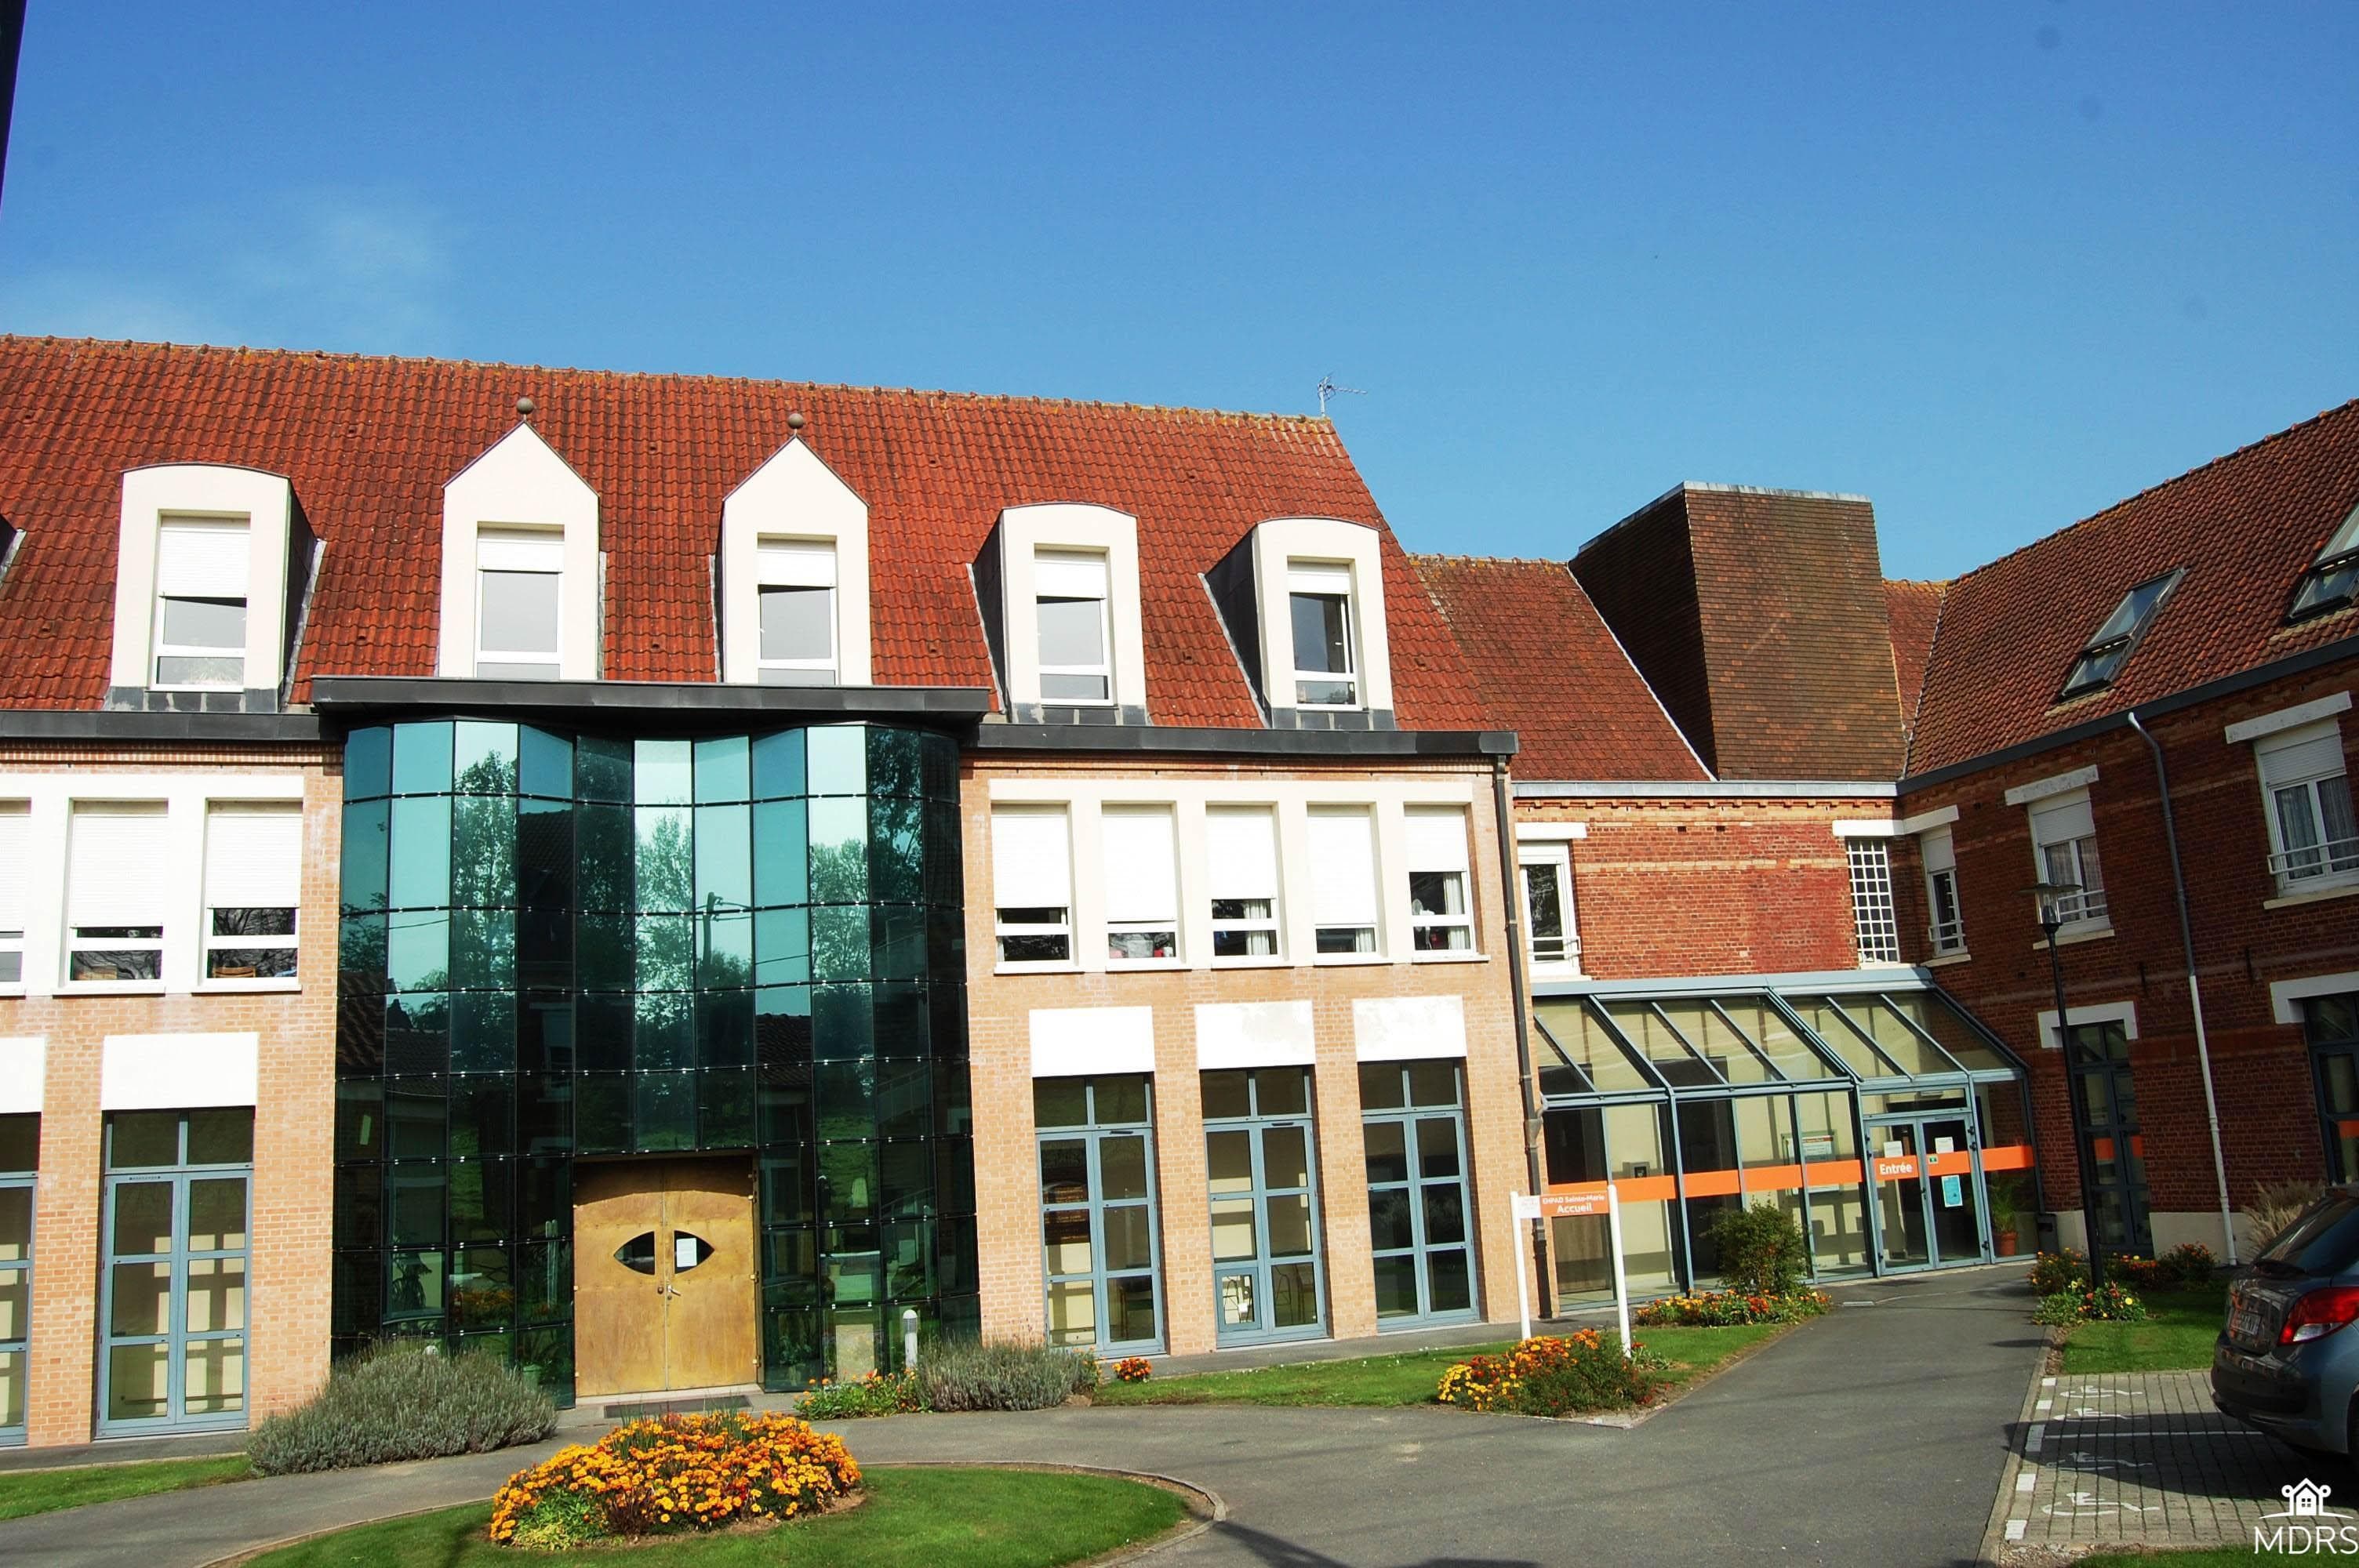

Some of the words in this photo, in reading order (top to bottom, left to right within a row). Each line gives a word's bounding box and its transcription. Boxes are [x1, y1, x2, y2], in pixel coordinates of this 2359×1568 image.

[1879, 1162, 1913, 1175] Entrée
[1565, 1194, 1605, 1203] Sainte-Marie
[1558, 1203, 1592, 1214] Accueil
